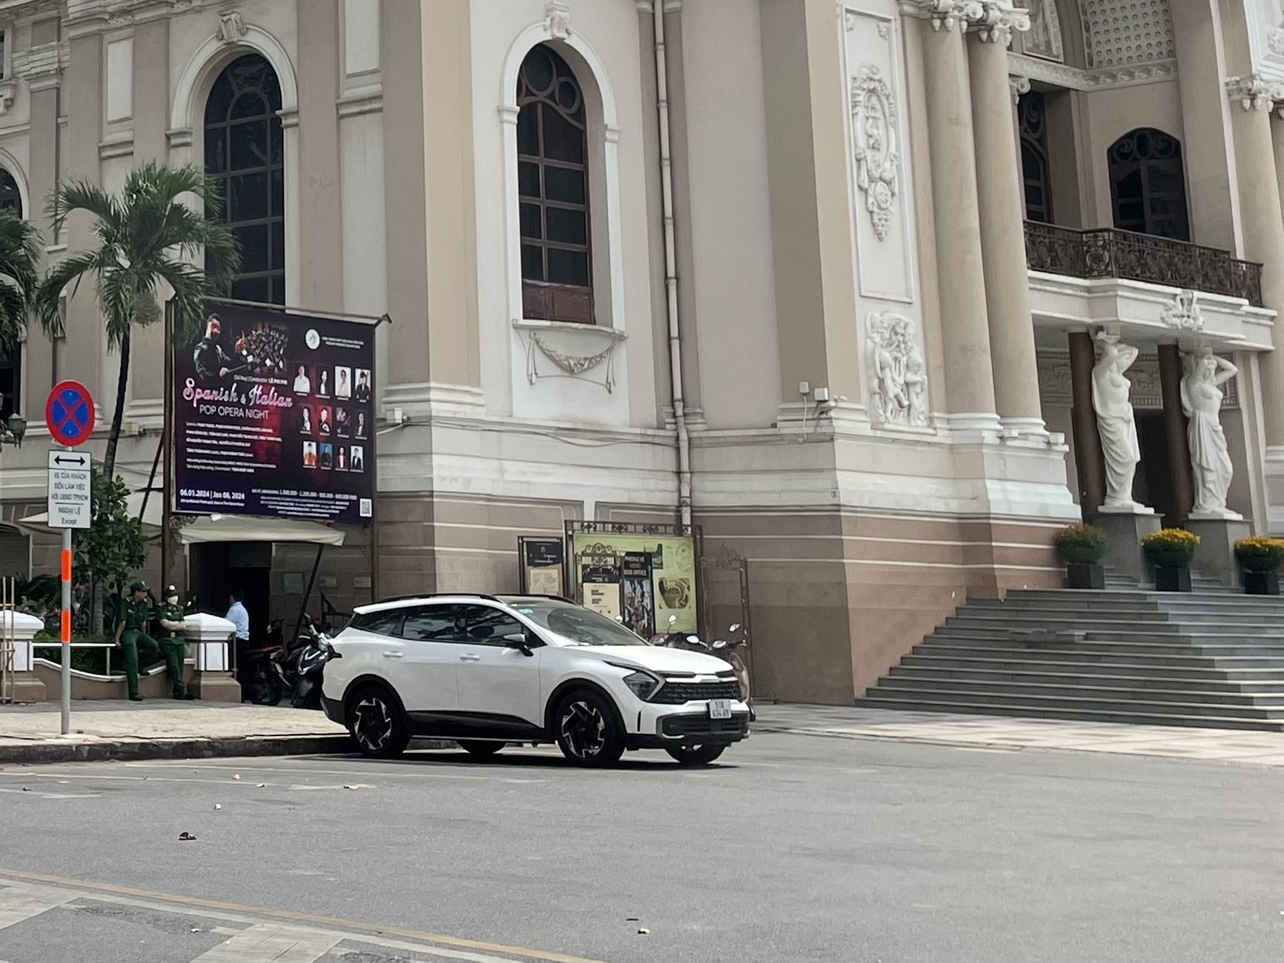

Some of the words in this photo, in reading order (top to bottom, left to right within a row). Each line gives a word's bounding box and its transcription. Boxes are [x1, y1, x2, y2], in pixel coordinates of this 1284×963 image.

[183, 377, 239, 408] Spanish
[248, 384, 293, 408] Italian
[199, 404, 217, 415] POP
[217, 406, 244, 418] OPERA
[245, 408, 270, 419] NIGHT
[179, 488, 210, 497] 06.01.2024
[231, 492, 245, 500] 2024
[61, 517, 77, 525] Except
